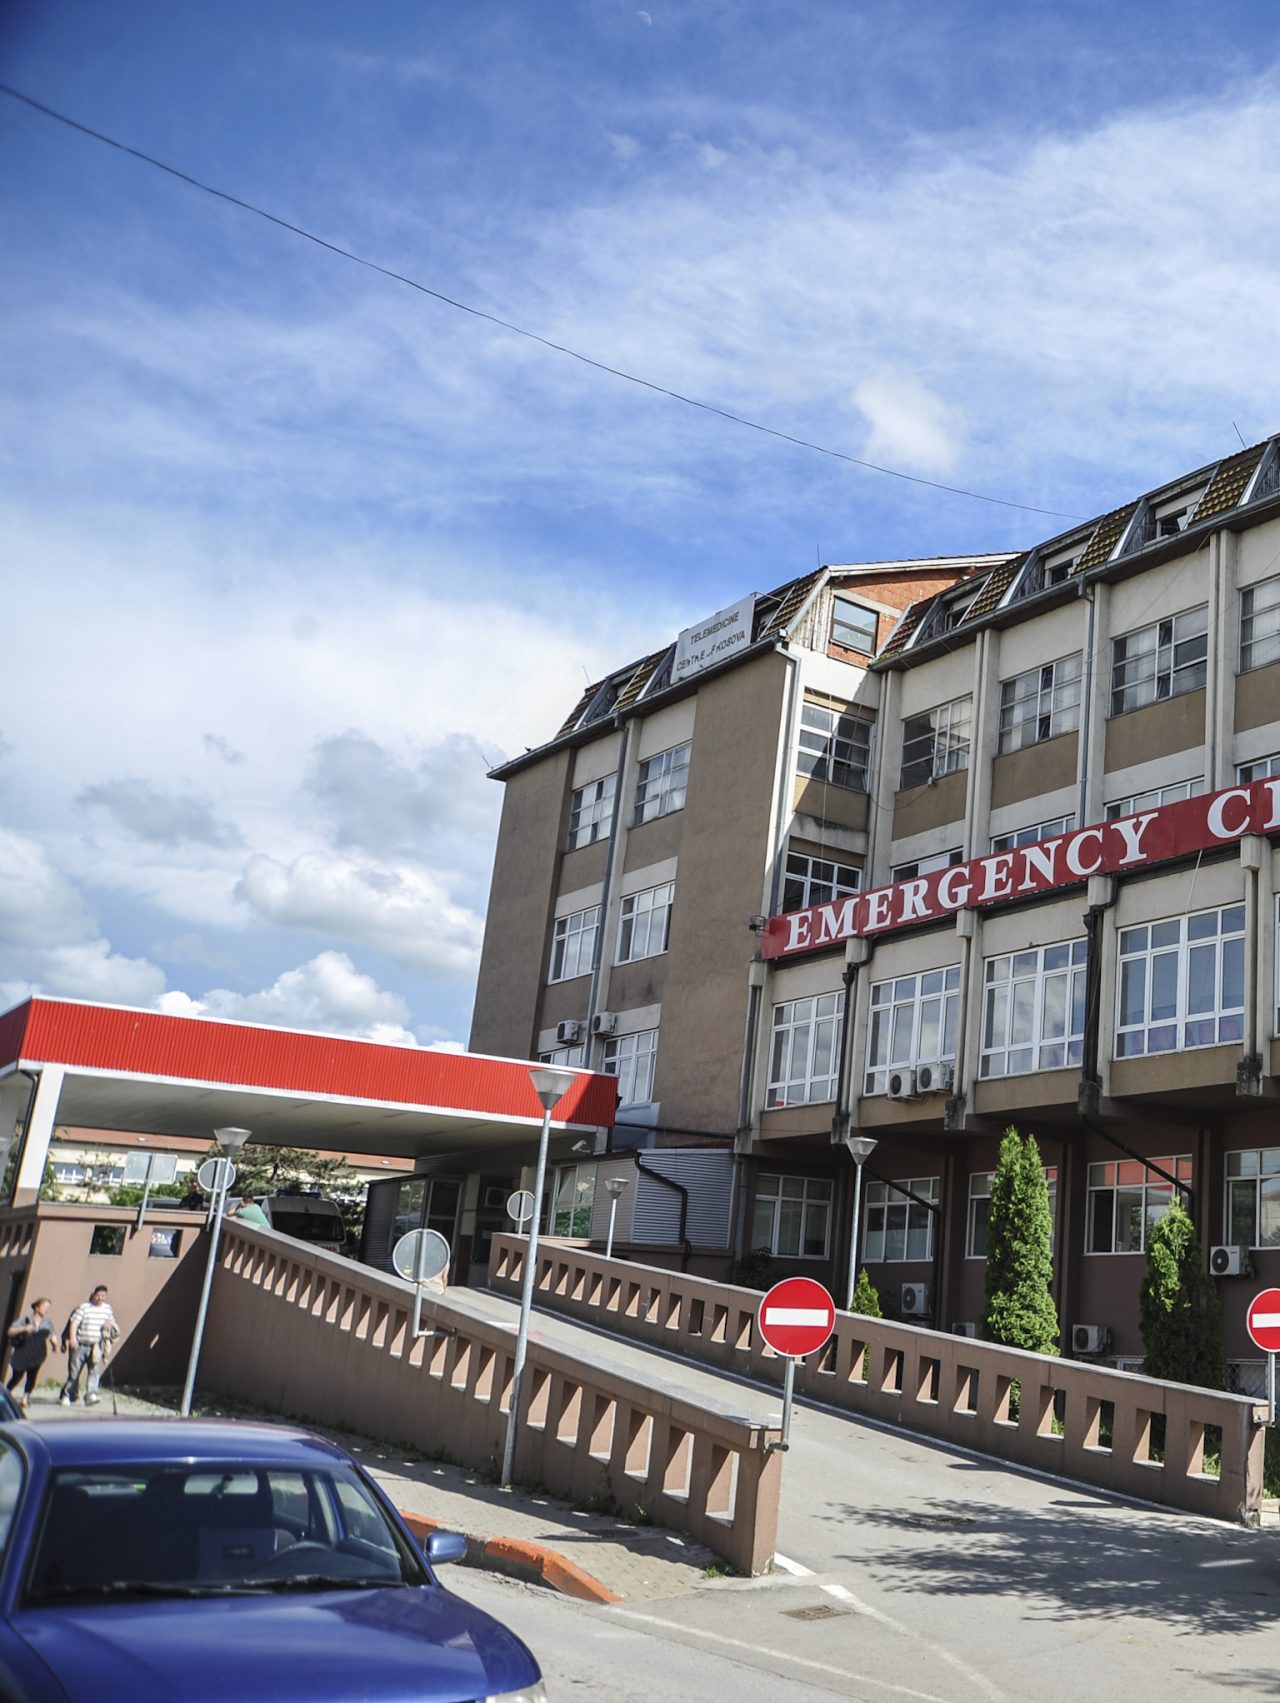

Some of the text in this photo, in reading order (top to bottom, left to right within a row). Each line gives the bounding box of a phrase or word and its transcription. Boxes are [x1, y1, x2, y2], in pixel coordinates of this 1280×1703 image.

[690, 611, 740, 645] TELEMEDICINE
[716, 630, 746, 653] KOSOVA
[783, 812, 1159, 952] EMERGENCY
